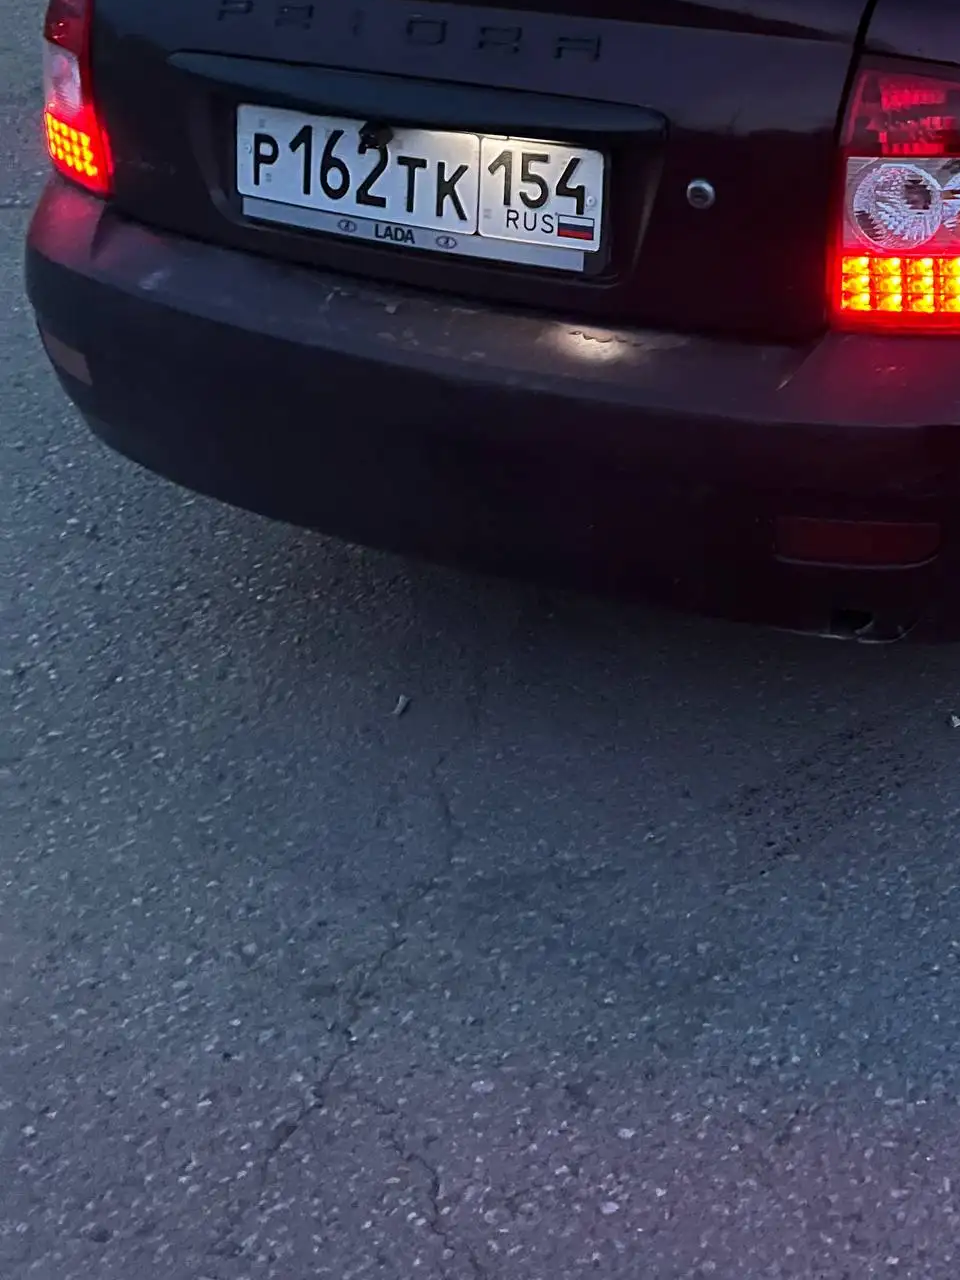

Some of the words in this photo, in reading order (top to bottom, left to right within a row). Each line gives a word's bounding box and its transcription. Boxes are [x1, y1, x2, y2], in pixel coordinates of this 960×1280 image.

[487, 150, 586, 216] 154
[374, 223, 416, 246] LADA
[505, 208, 555, 235] RUS
